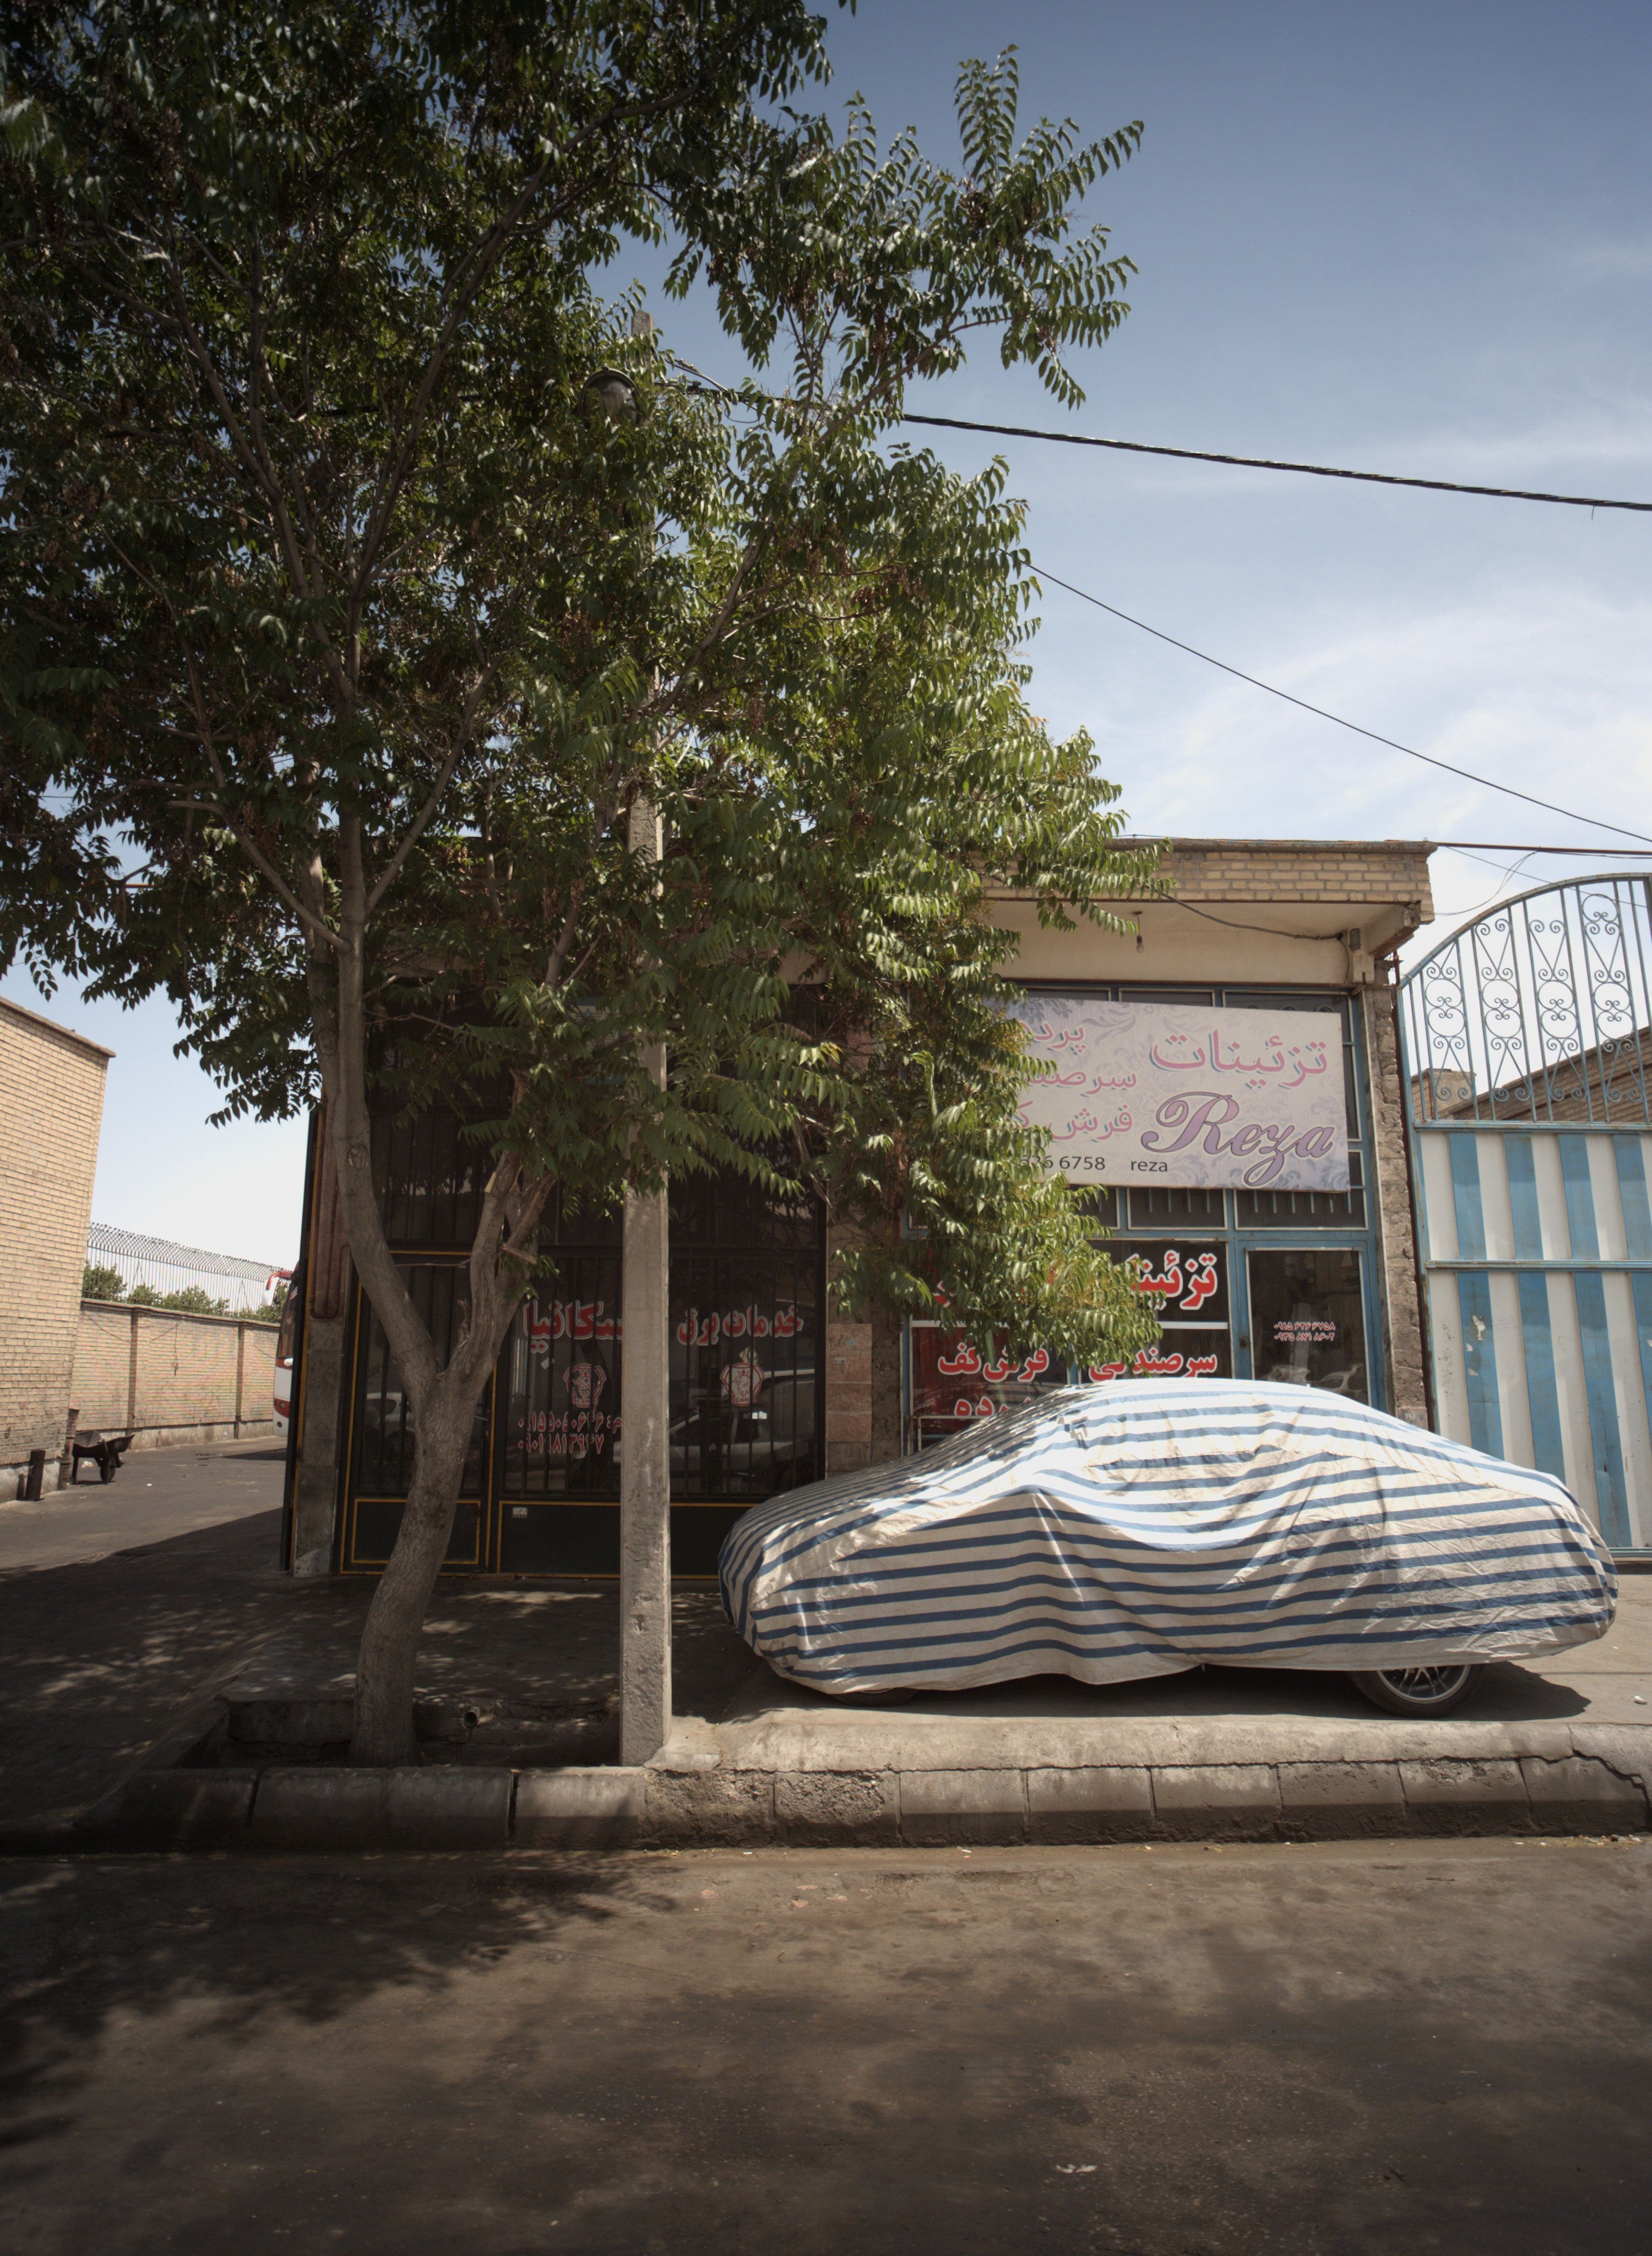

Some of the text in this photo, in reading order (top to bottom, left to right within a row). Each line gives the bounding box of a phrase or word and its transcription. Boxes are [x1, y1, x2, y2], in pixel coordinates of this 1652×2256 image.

[1151, 1029, 1328, 1091] تزئینات
[1048, 1104, 1133, 1142] فرش
[1140, 1091, 1335, 1187] Reza
[1059, 1156, 1106, 1170] 6758
[1131, 1158, 1168, 1172] reza
